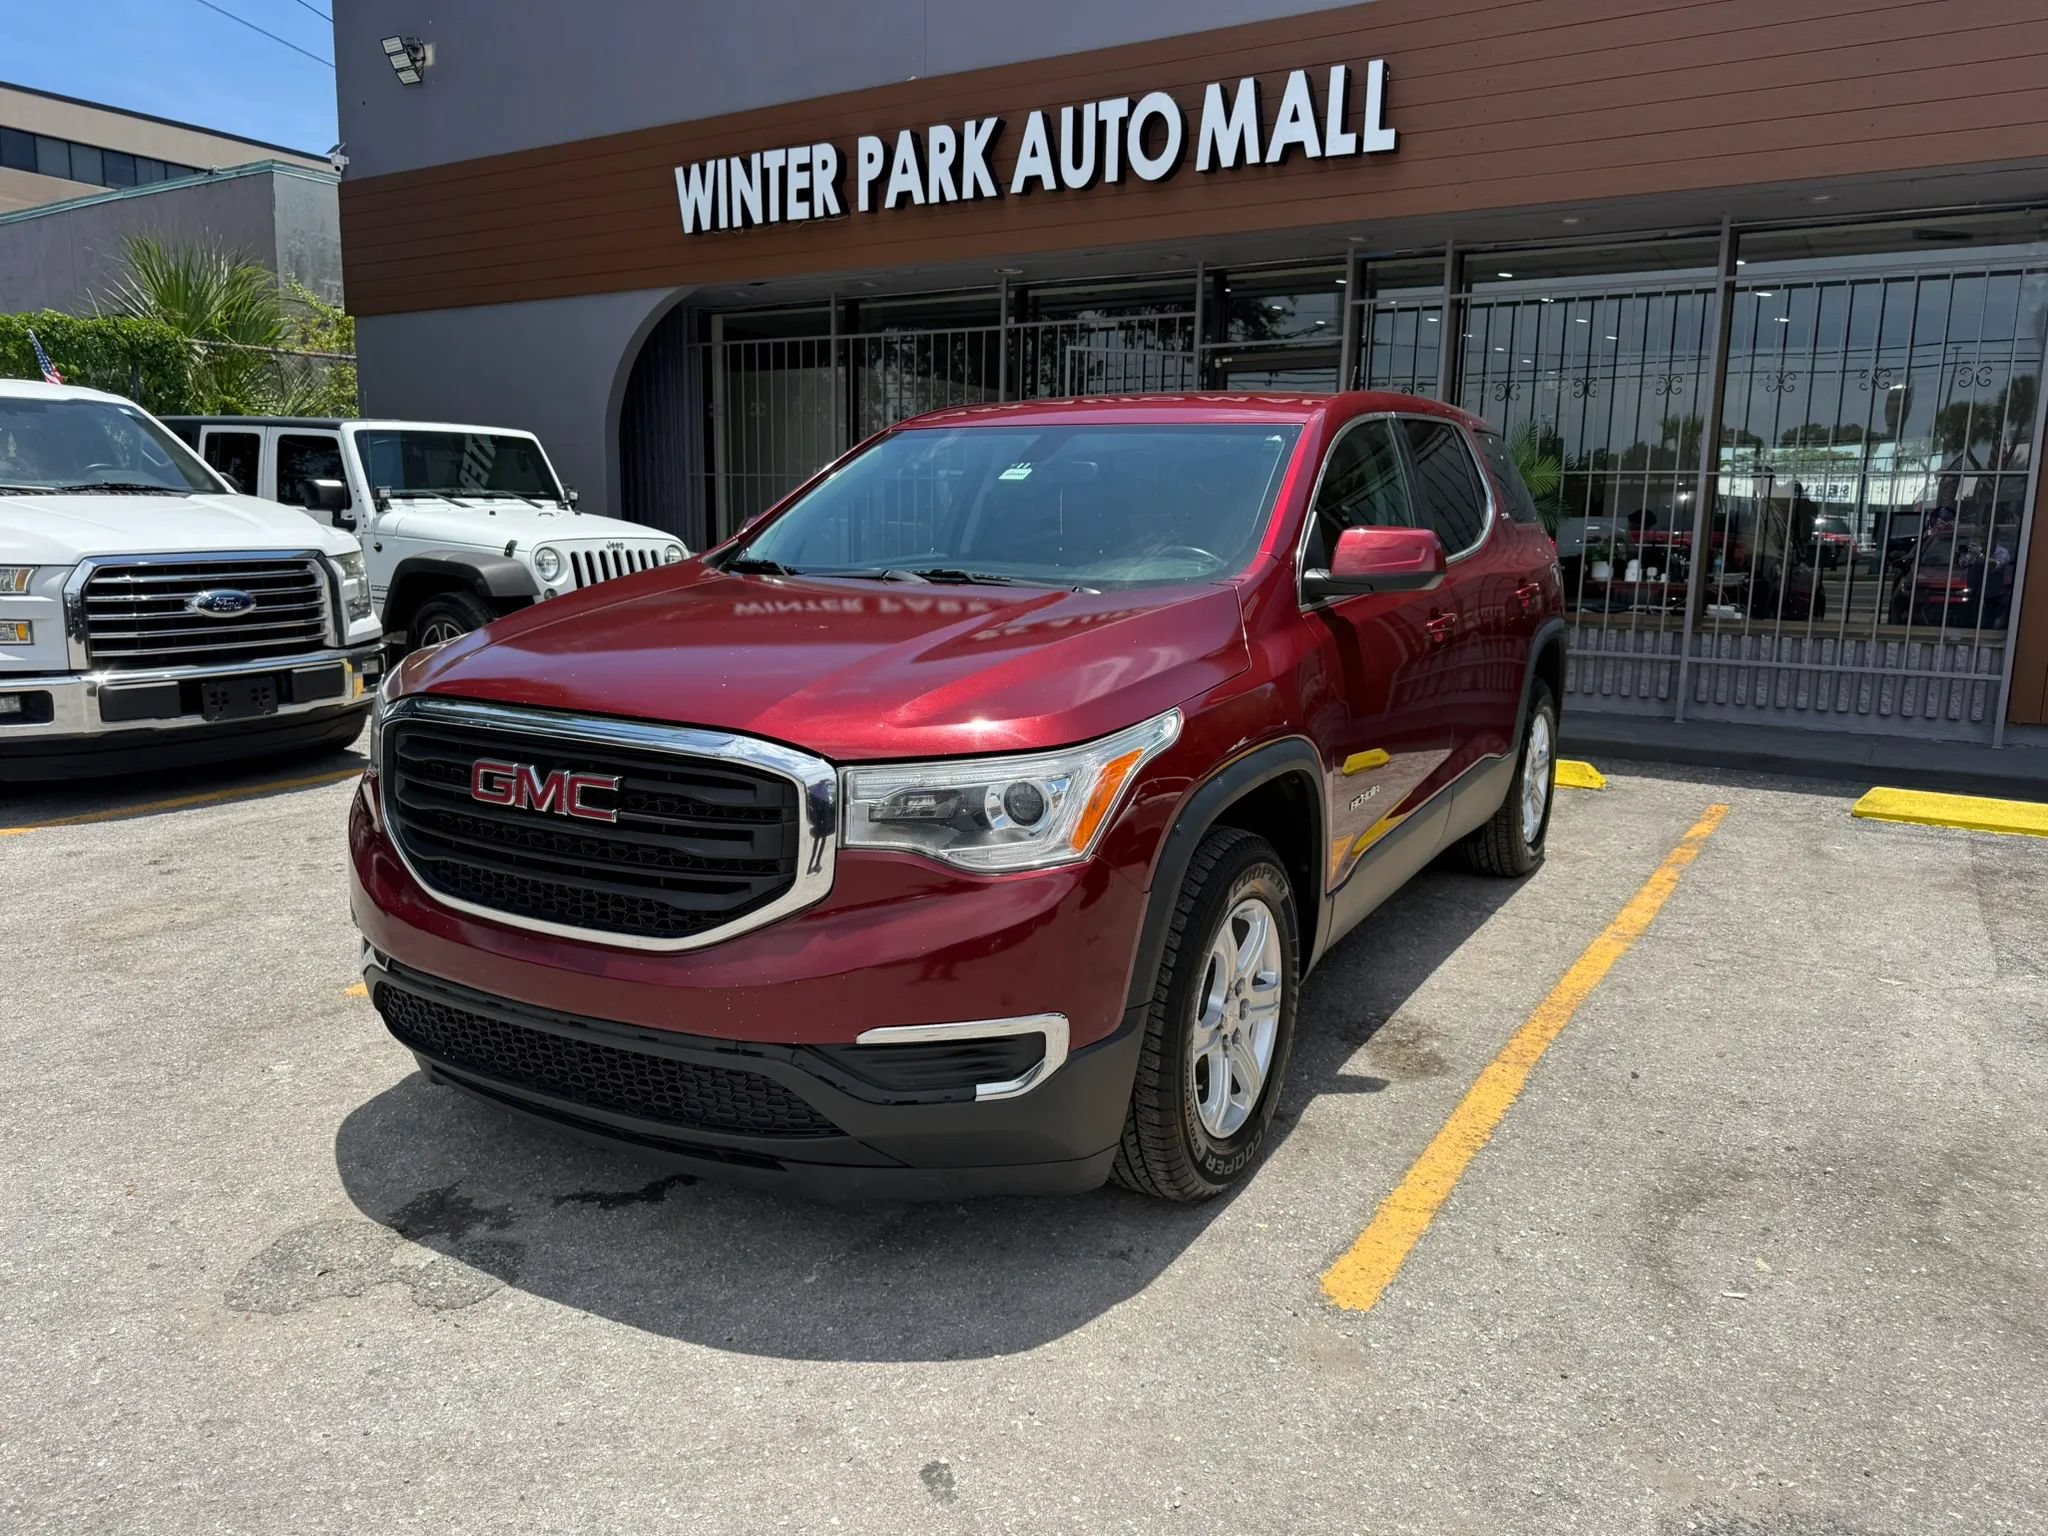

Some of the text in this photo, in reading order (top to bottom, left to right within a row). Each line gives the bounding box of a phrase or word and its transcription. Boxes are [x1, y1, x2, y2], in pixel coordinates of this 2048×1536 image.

[674, 59, 1397, 235] WINTER PARK AUTO MALL
[606, 540, 624, 551] Jeep
[471, 757, 619, 824] GMC
[1232, 863, 1288, 898] COOPER
[1184, 1060, 1203, 1156] EVOLUTION
[1205, 1130, 1263, 1176] COOPER
